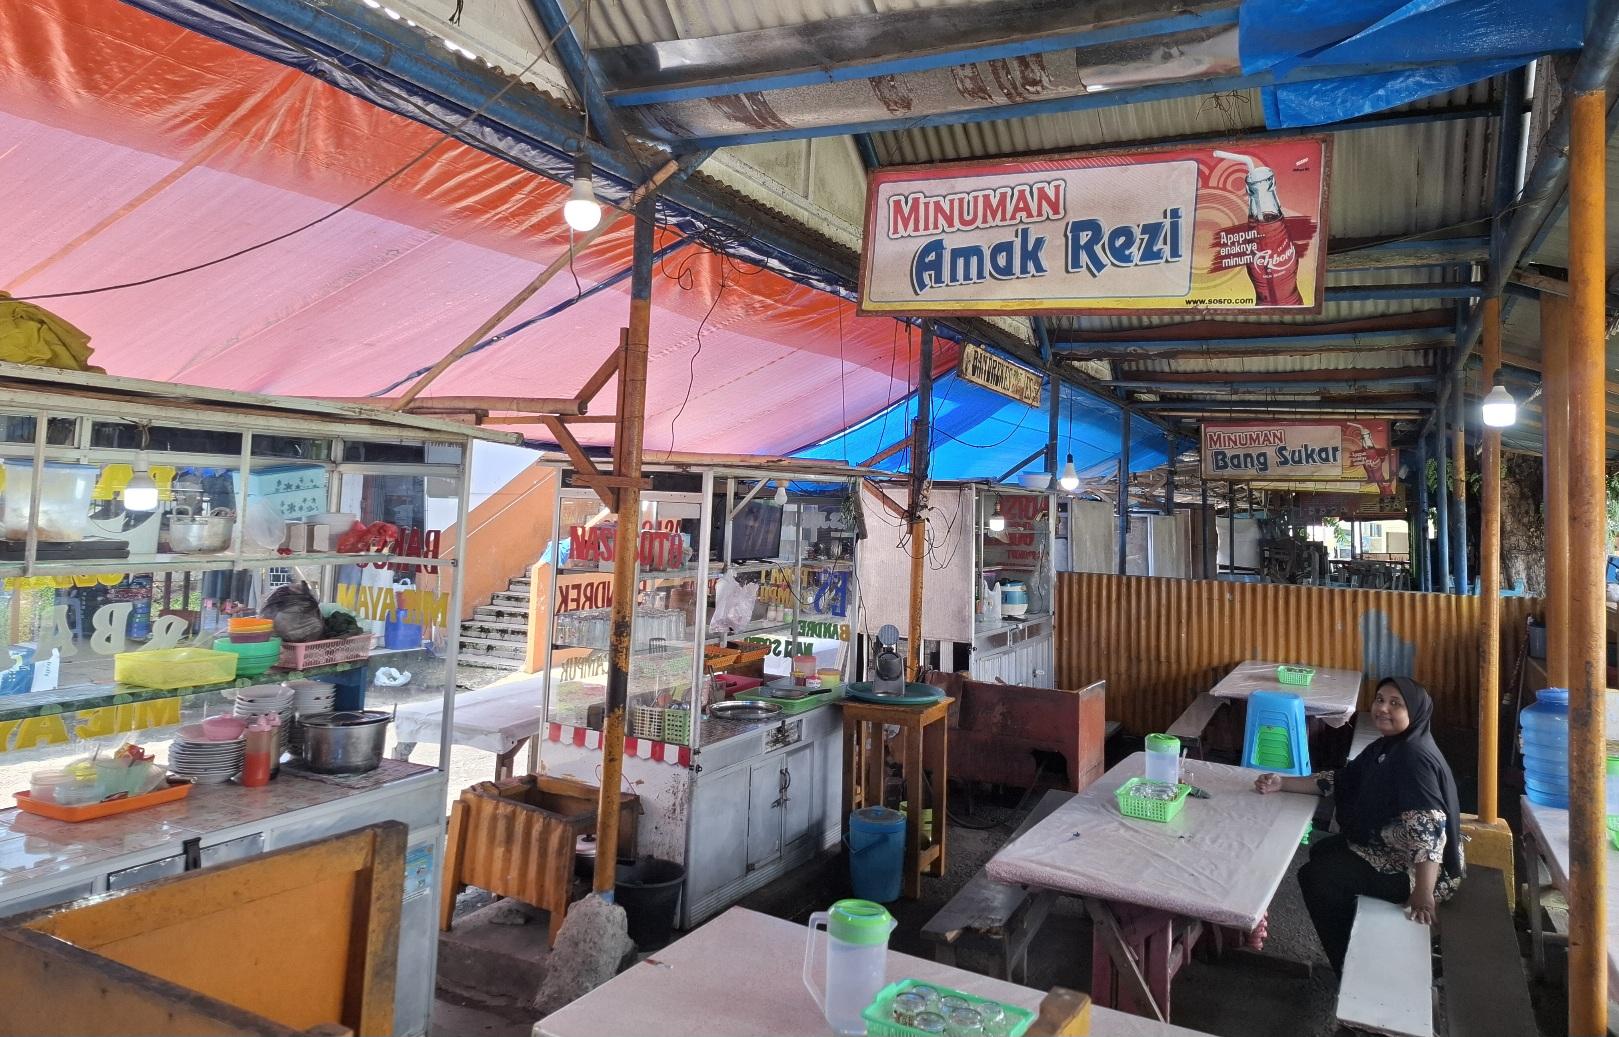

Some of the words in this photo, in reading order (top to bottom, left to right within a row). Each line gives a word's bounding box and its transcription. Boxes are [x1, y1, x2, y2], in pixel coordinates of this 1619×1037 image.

[890, 181, 1065, 238] MINUMAN
[1220, 230, 1266, 245] Apapun...
[913, 227, 1047, 295] Amak
[1066, 208, 1183, 277] Rezi
[1220, 242, 1258, 256] enaknya
[1222, 254, 1253, 268] minum
[1185, 297, 1254, 306] www.sosro.com
[1207, 430, 1286, 450] MINUMAN
[1212, 449, 1269, 474] Bang
[1275, 443, 1340, 468] Sukar
